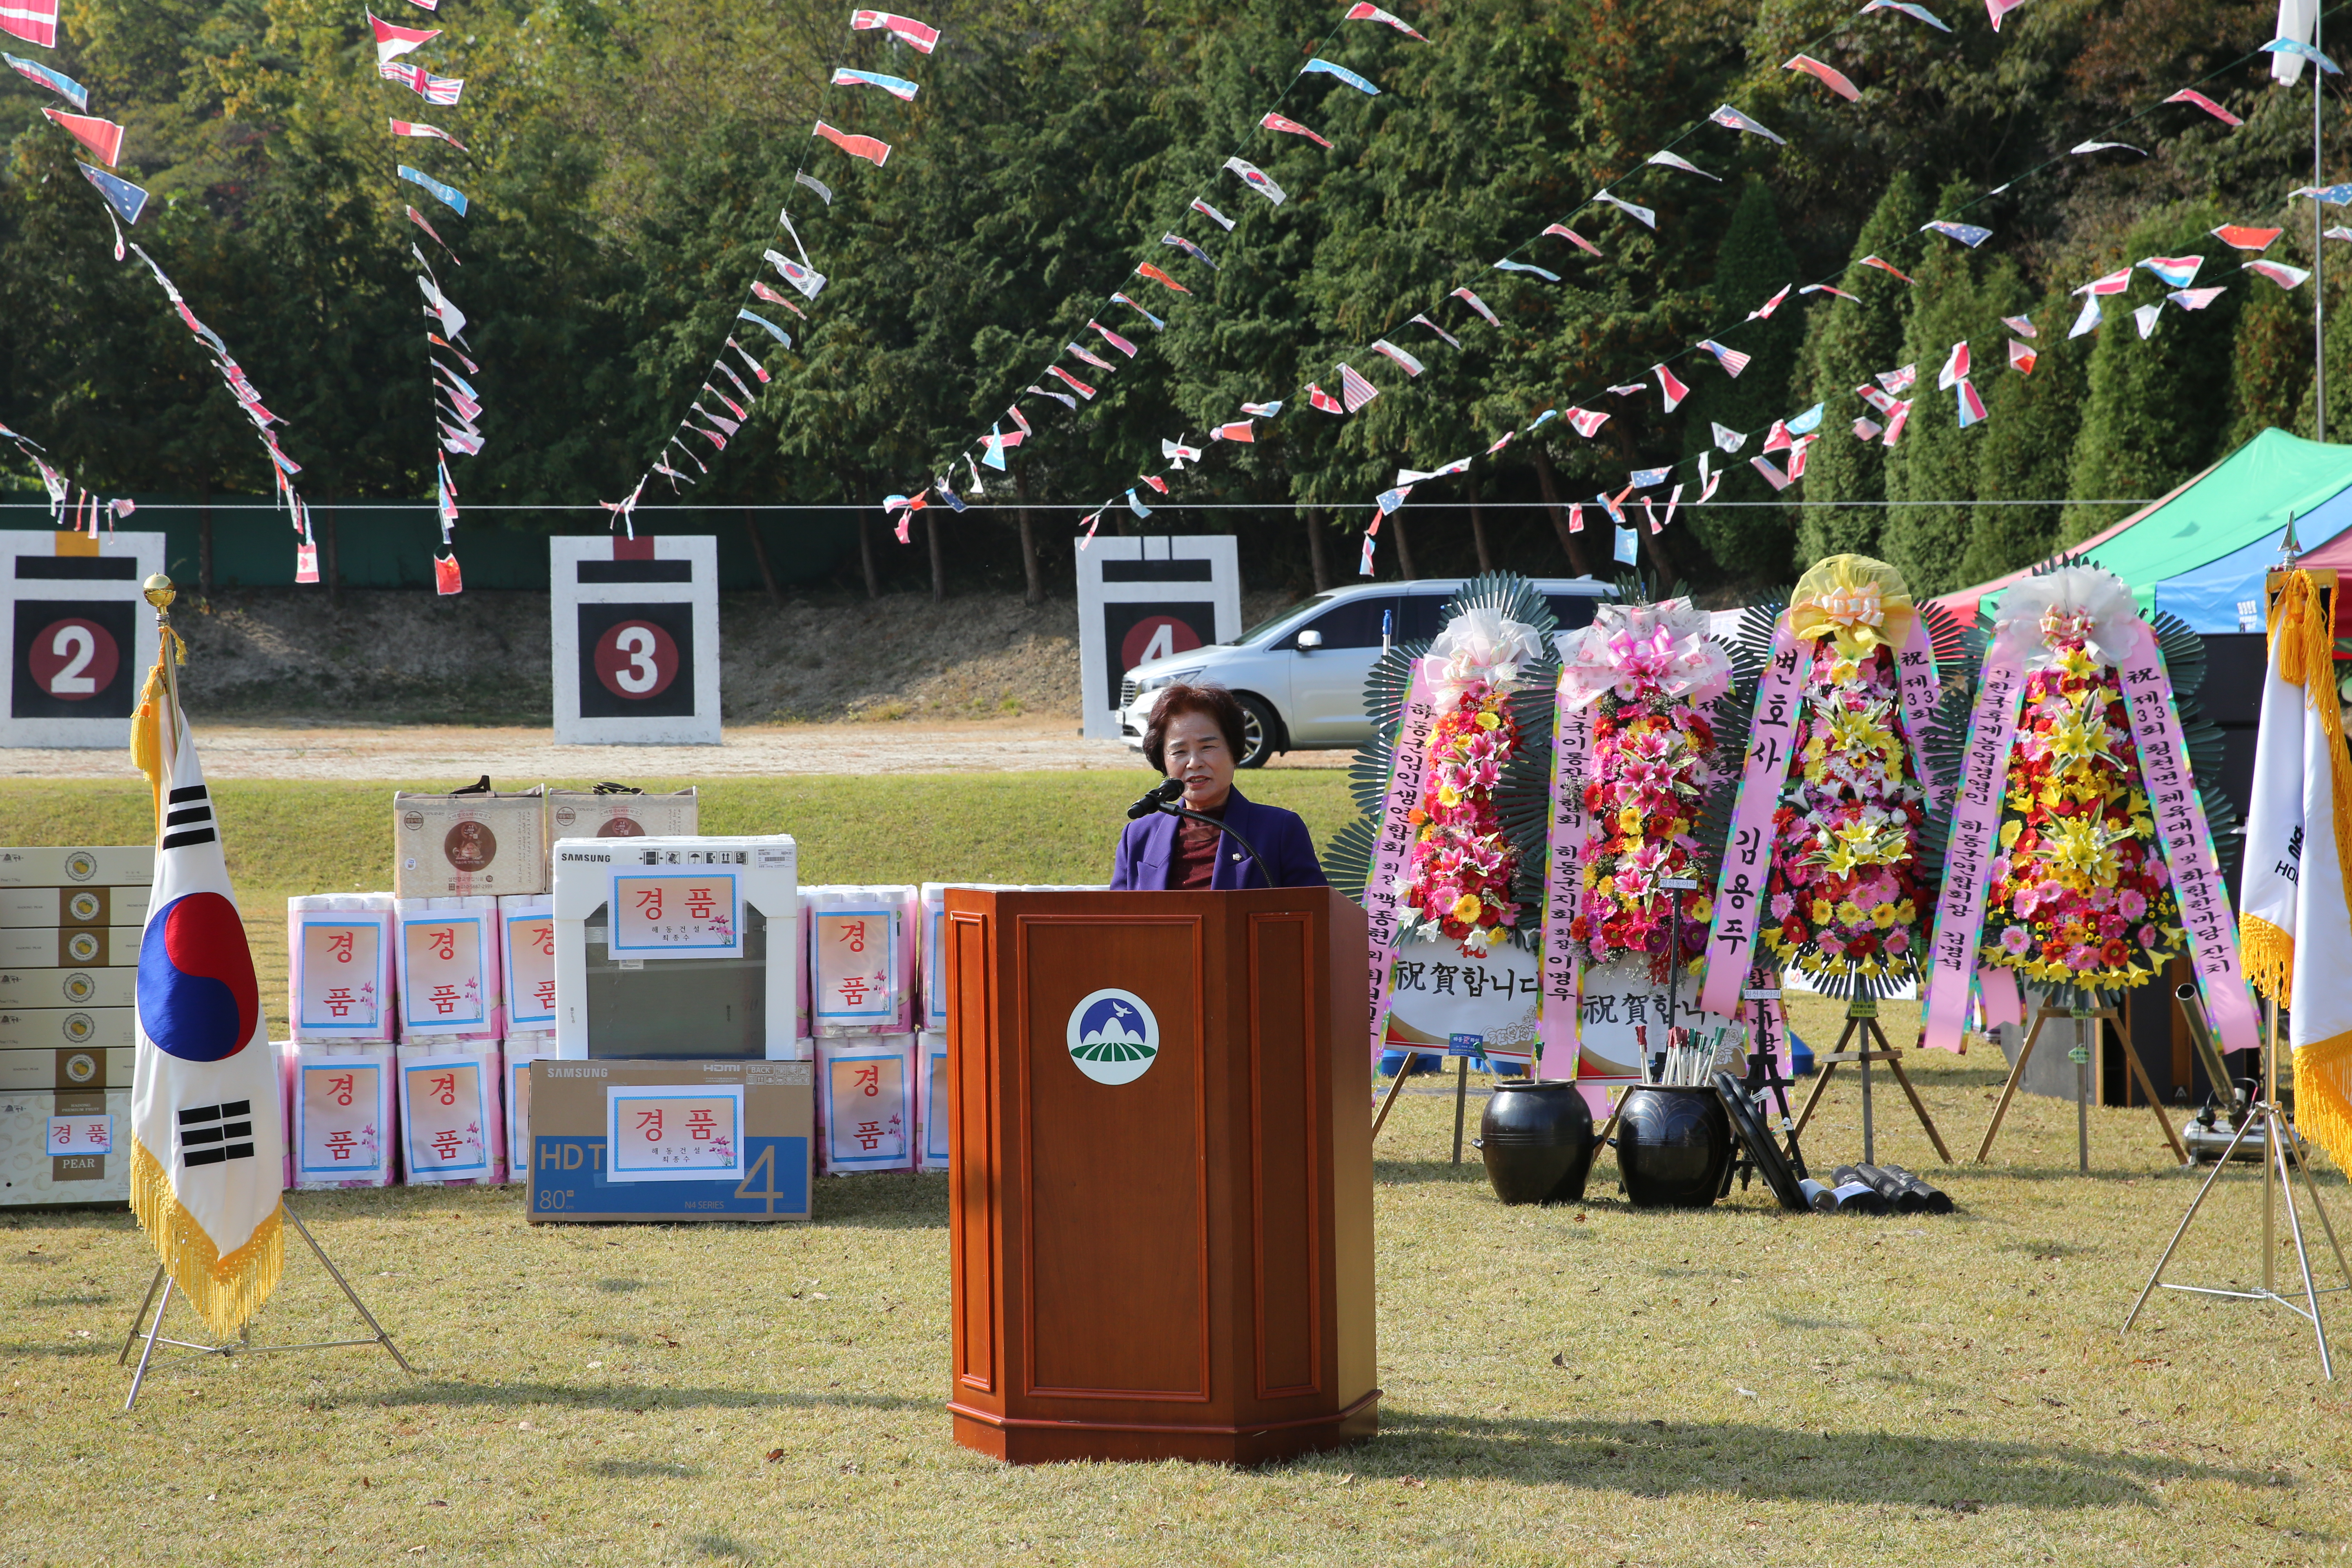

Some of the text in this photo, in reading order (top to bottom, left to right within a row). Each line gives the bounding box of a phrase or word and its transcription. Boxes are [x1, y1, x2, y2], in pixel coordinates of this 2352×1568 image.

[51, 626, 95, 693] 2
[616, 626, 658, 693] 3
[1140, 624, 1173, 665] 4
[1901, 652, 1929, 666] 祝
[2127, 668, 2160, 684] 祝
[2180, 853, 2198, 865] 및
[1717, 649, 1797, 955] 변호사 김용주
[561, 853, 610, 862] SAMSUNG
[1944, 820, 1989, 917] 하동군연합회장
[1662, 880, 1696, 888] 횡천동아리
[1368, 892, 1397, 945] 백종현
[1553, 928, 1572, 949] 회장
[1583, 993, 1733, 1026] 祝賀합니
[548, 1068, 608, 1078] SAMSUNG
[63, 1158, 95, 1169] PEAR
[541, 1145, 606, 1169] HDT
[735, 1145, 783, 1213] 4
[539, 1190, 566, 1209] 80
